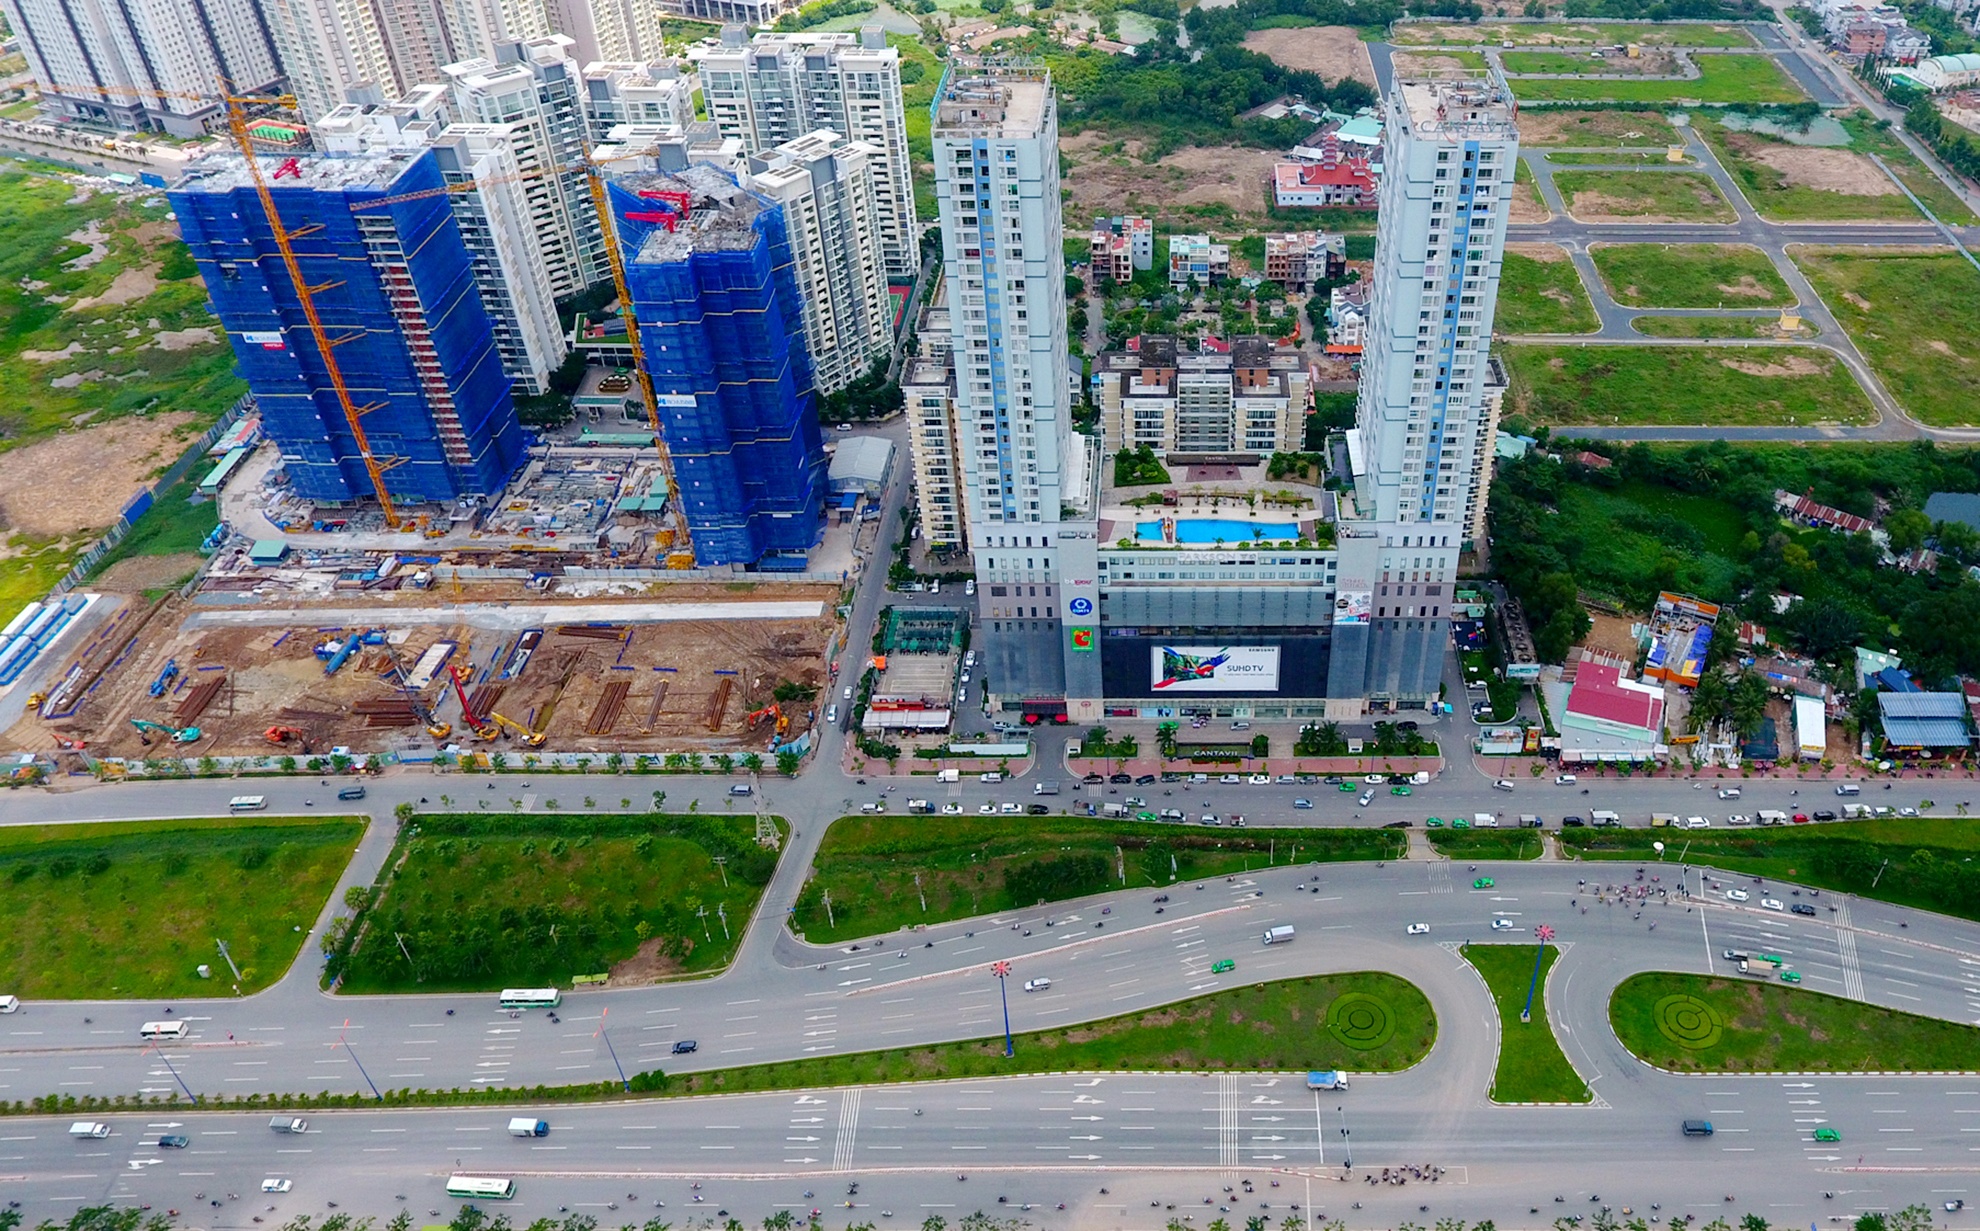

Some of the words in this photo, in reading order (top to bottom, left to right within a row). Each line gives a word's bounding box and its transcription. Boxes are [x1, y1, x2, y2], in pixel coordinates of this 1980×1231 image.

[1179, 552, 1236, 562] PARKSON
[1226, 664, 1252, 672] SUHD
[1252, 664, 1264, 672] TV
